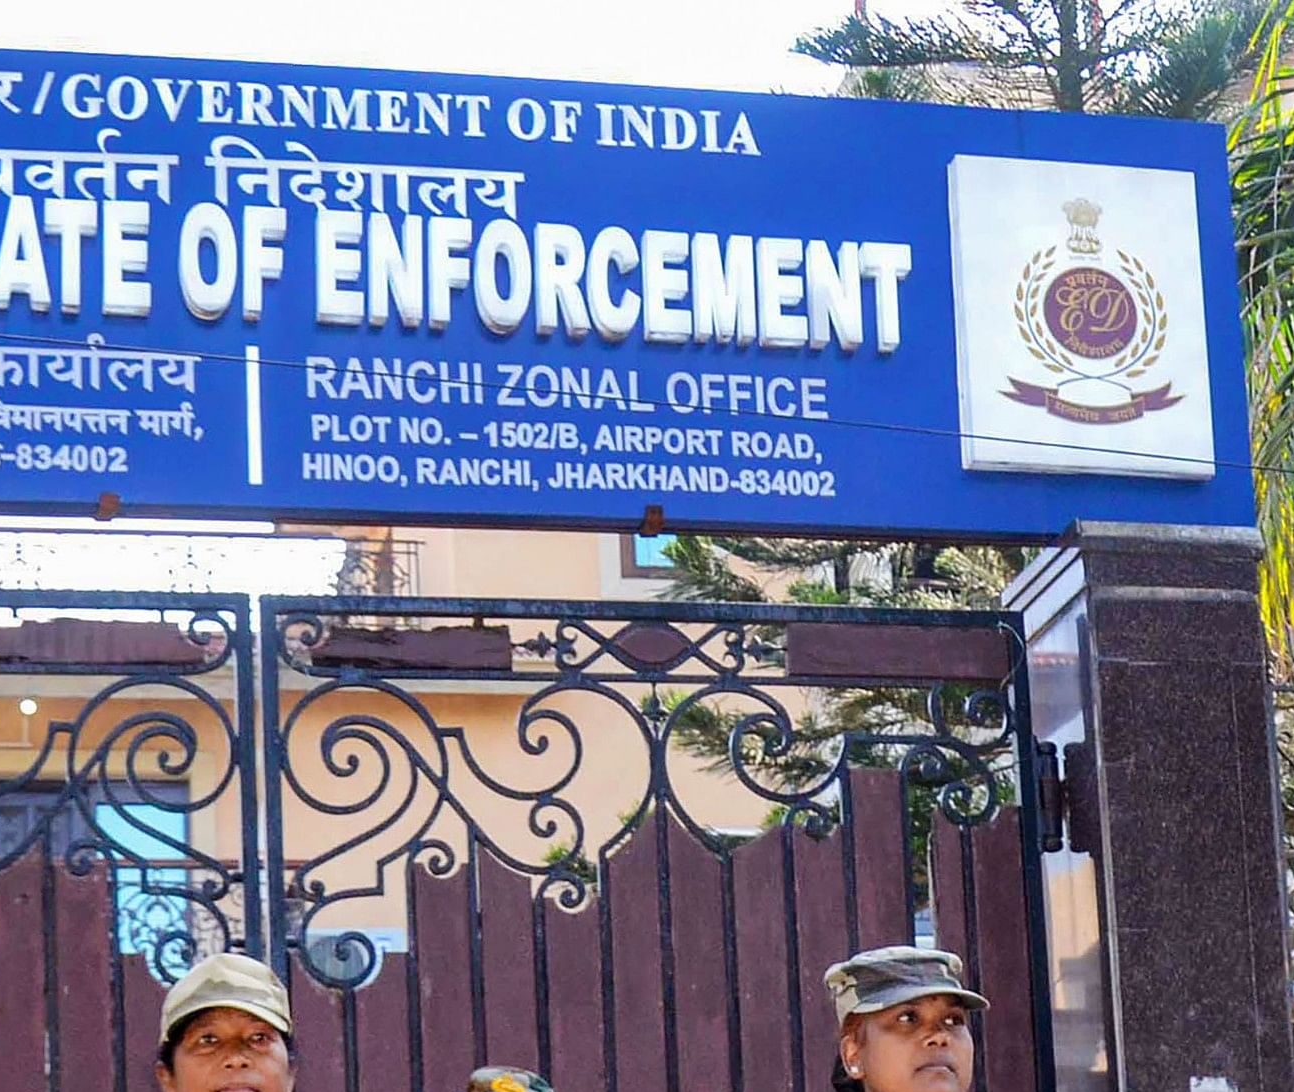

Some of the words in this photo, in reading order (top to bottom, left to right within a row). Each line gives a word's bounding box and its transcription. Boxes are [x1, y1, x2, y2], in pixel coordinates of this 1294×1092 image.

[507, 97, 582, 142] OF
[595, 103, 762, 156] INDIA
[205, 136, 525, 219] निदेशालय
[179, 202, 287, 321] OF
[314, 206, 912, 352] ENFORCEMENT
[306, 356, 483, 405] RANCHI
[497, 364, 656, 413] ZONAL
[667, 372, 829, 420] OFFICE
[135, 403, 204, 441] मार्ग,
[311, 414, 392, 443] PLOT
[399, 417, 452, 446] NO.
[483, 421, 588, 454] 1502/B,
[594, 424, 723, 457] AIRPORT
[731, 431, 822, 464] ROAD,
[303, 453, 408, 487] HINOO,
[416, 458, 541, 492] RANCHI,
[548, 463, 836, 498] JHARKHAND-834002
